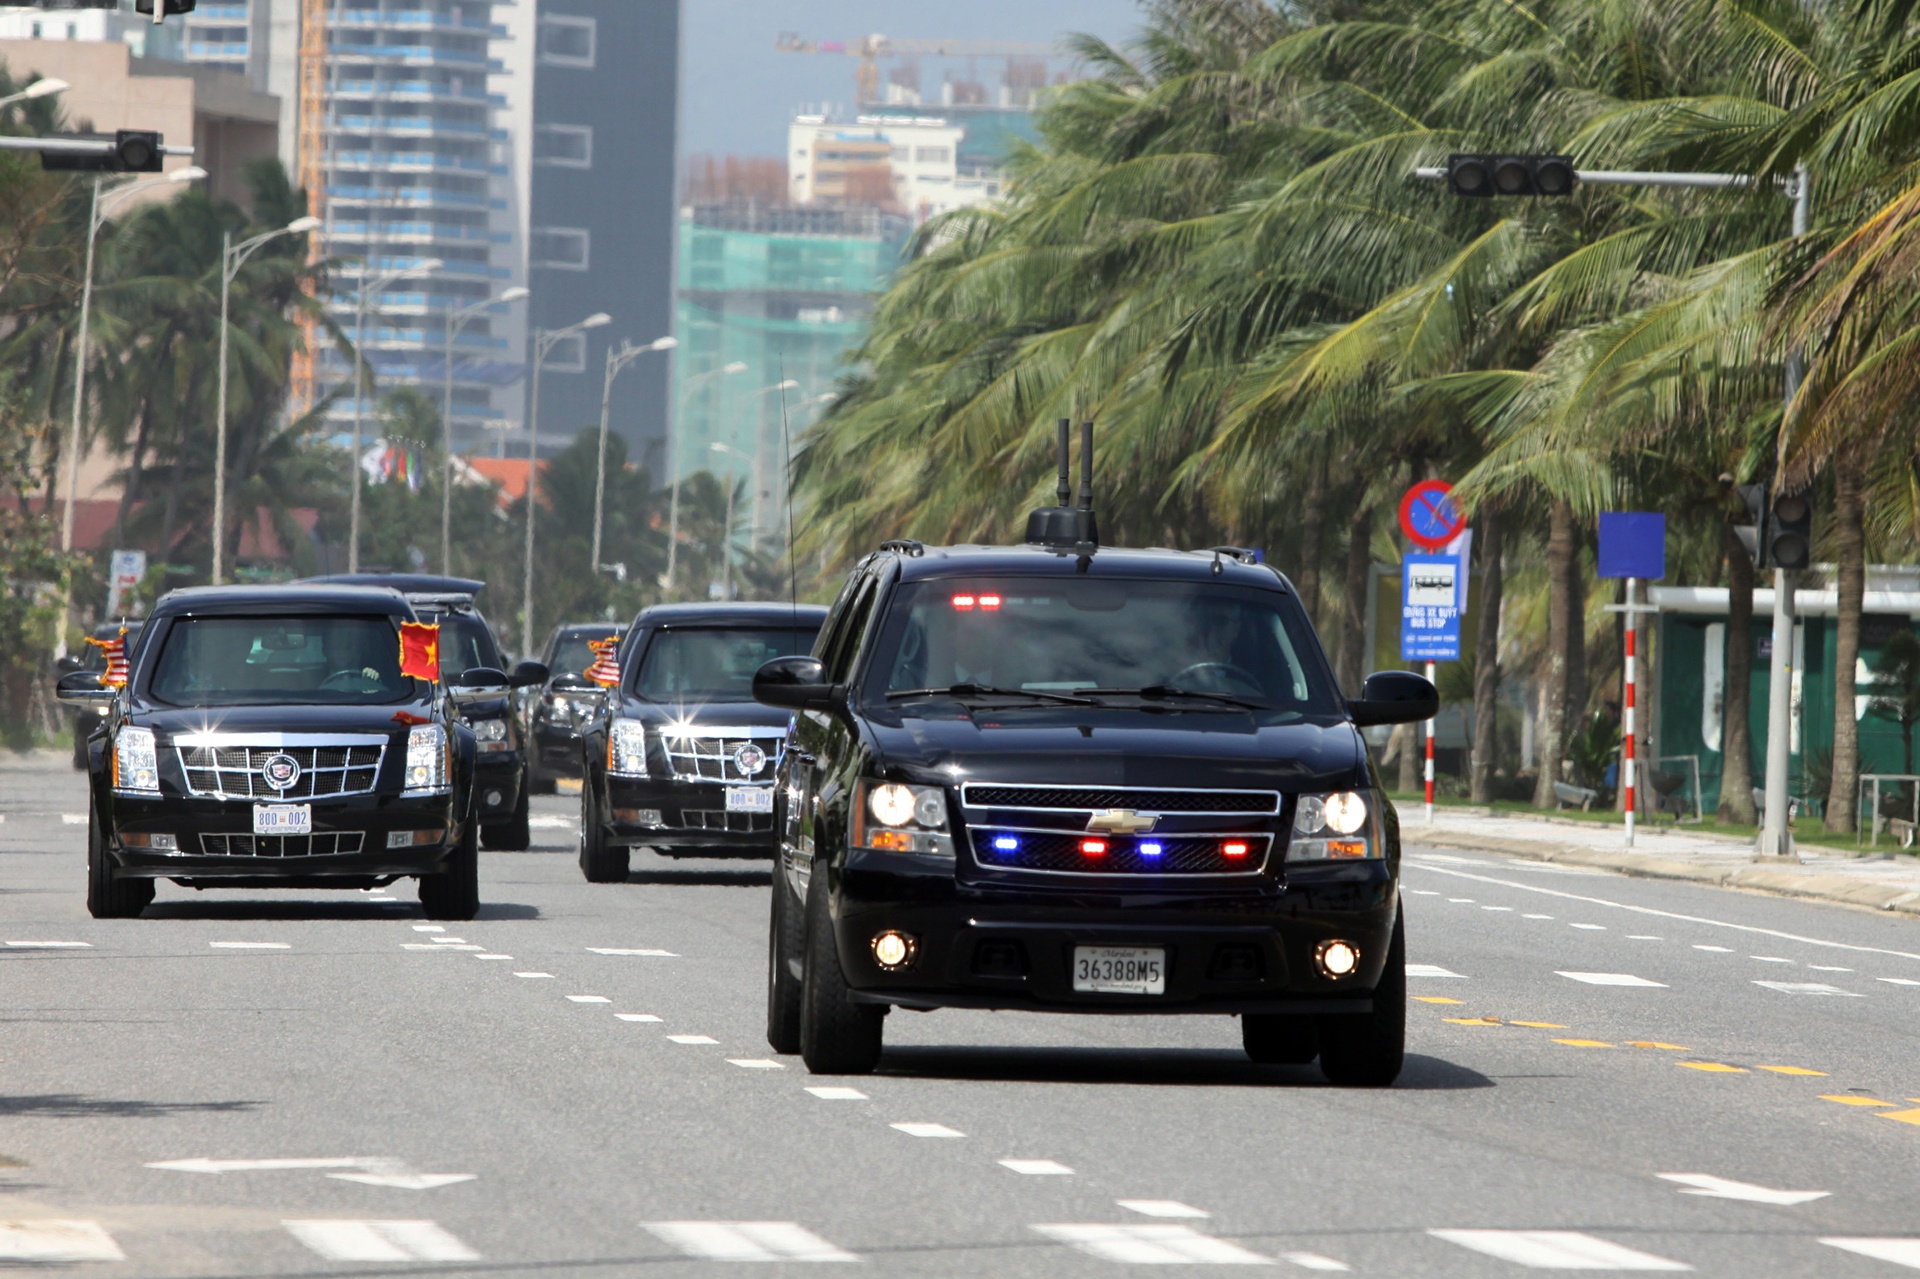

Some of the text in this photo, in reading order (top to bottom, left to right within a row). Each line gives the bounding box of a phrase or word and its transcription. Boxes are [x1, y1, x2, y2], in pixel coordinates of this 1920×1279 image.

[1427, 617, 1446, 629] STOP
[259, 811, 307, 825] 800 002
[1078, 959, 1160, 983] 36388M5
